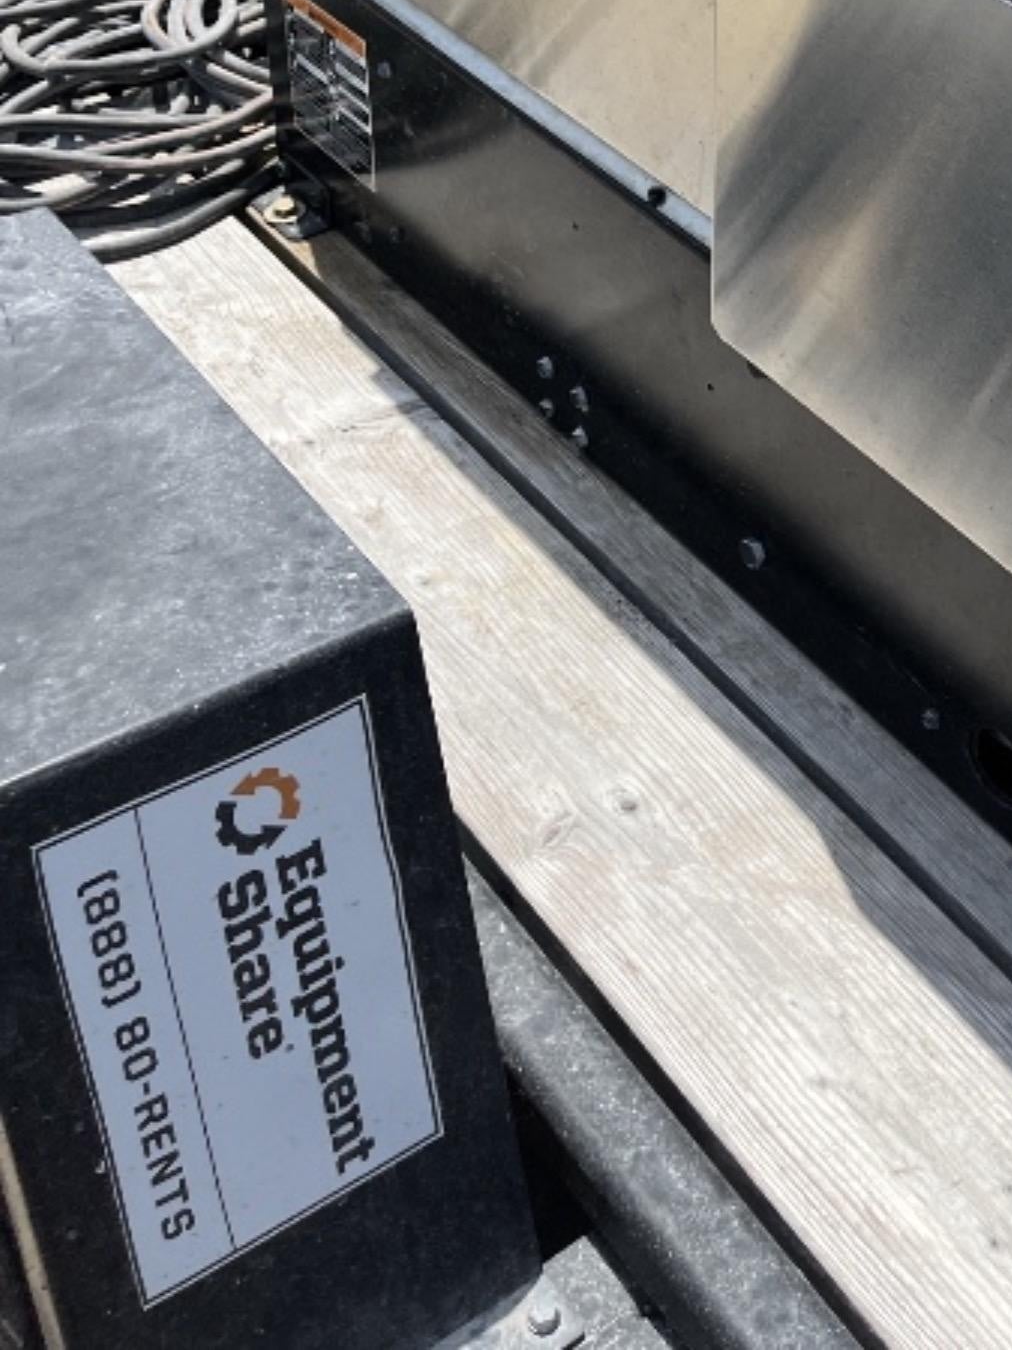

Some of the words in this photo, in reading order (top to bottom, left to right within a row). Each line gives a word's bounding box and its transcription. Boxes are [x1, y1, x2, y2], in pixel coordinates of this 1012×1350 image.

[75, 869, 142, 1008] (888)
[114, 1015, 197, 1241] 80-RENTS
[216, 869, 285, 1060] Share
[274, 837, 376, 1174] Equipment
